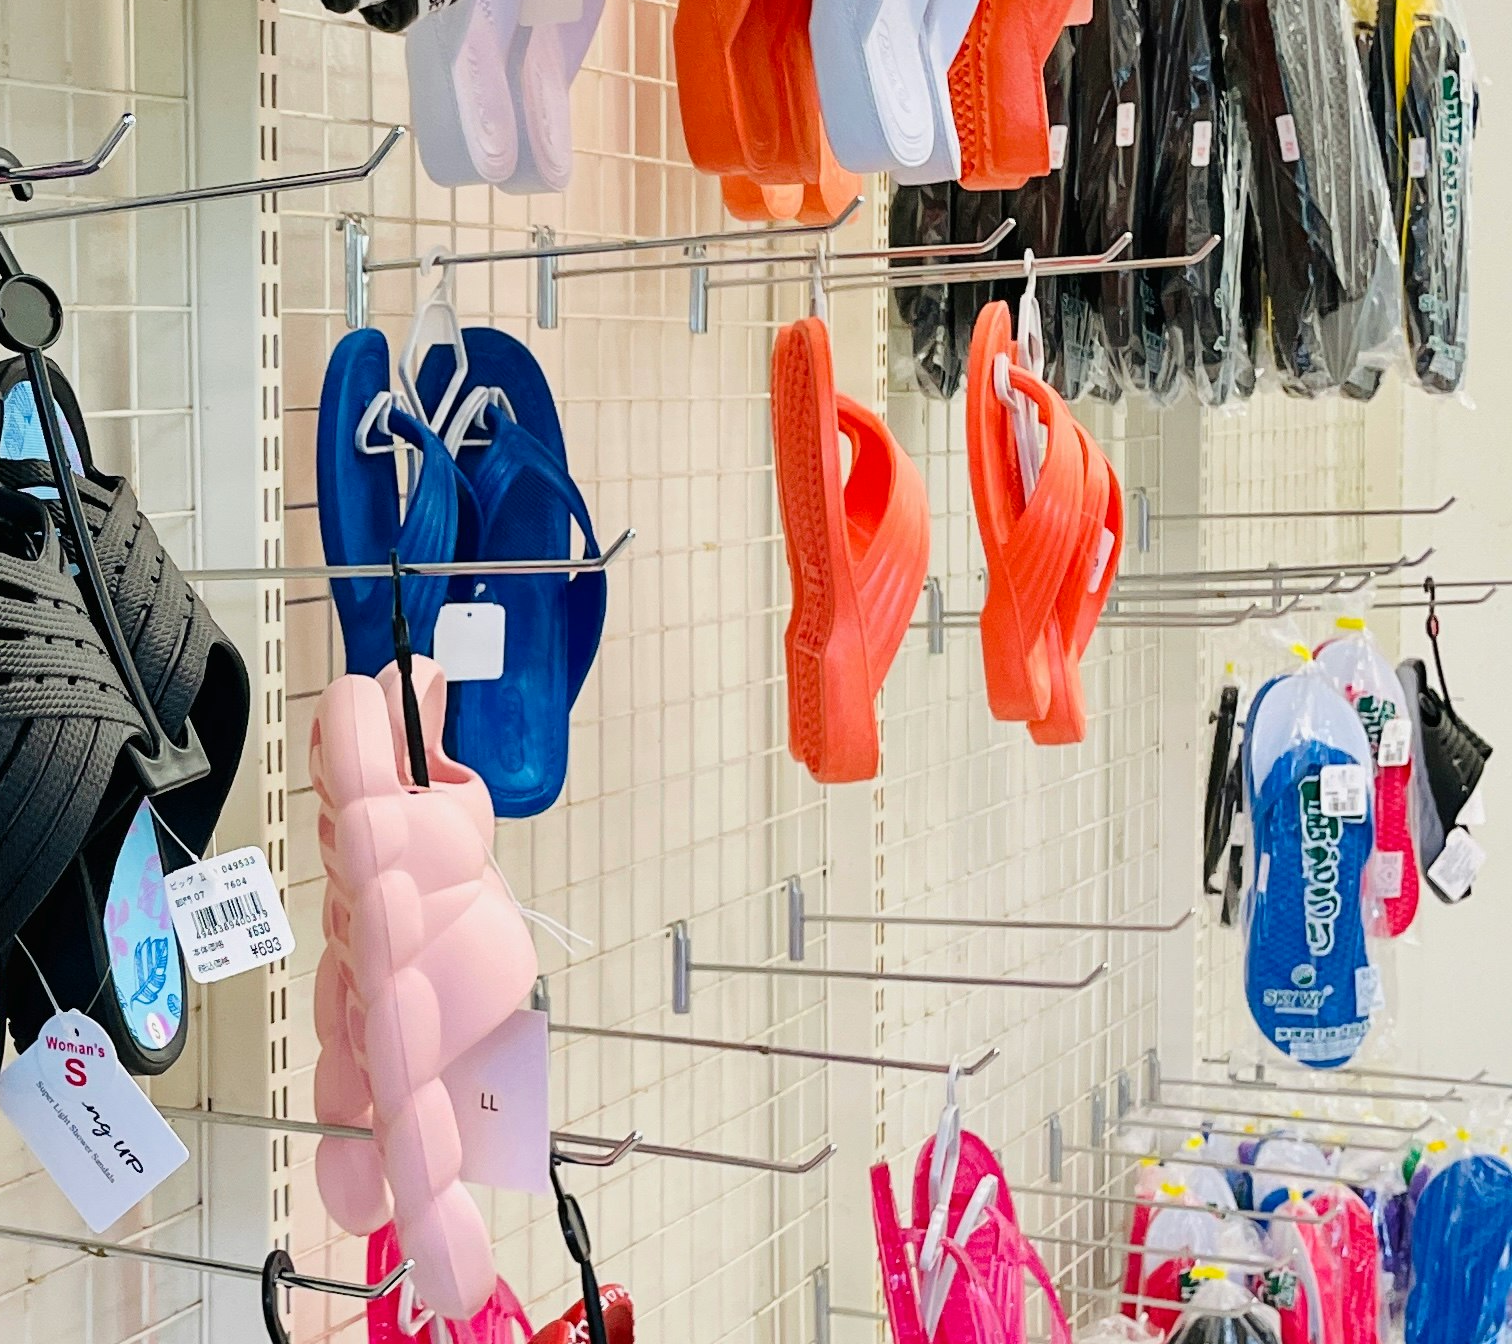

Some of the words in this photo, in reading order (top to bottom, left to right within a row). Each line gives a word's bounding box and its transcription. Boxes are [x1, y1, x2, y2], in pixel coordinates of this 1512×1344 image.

[247, 922, 271, 938] ¥630
[250, 937, 282, 958] ¥693
[151, 1022, 161, 1039] S
[65, 1058, 88, 1088] S
[481, 1092, 499, 1112] LL
